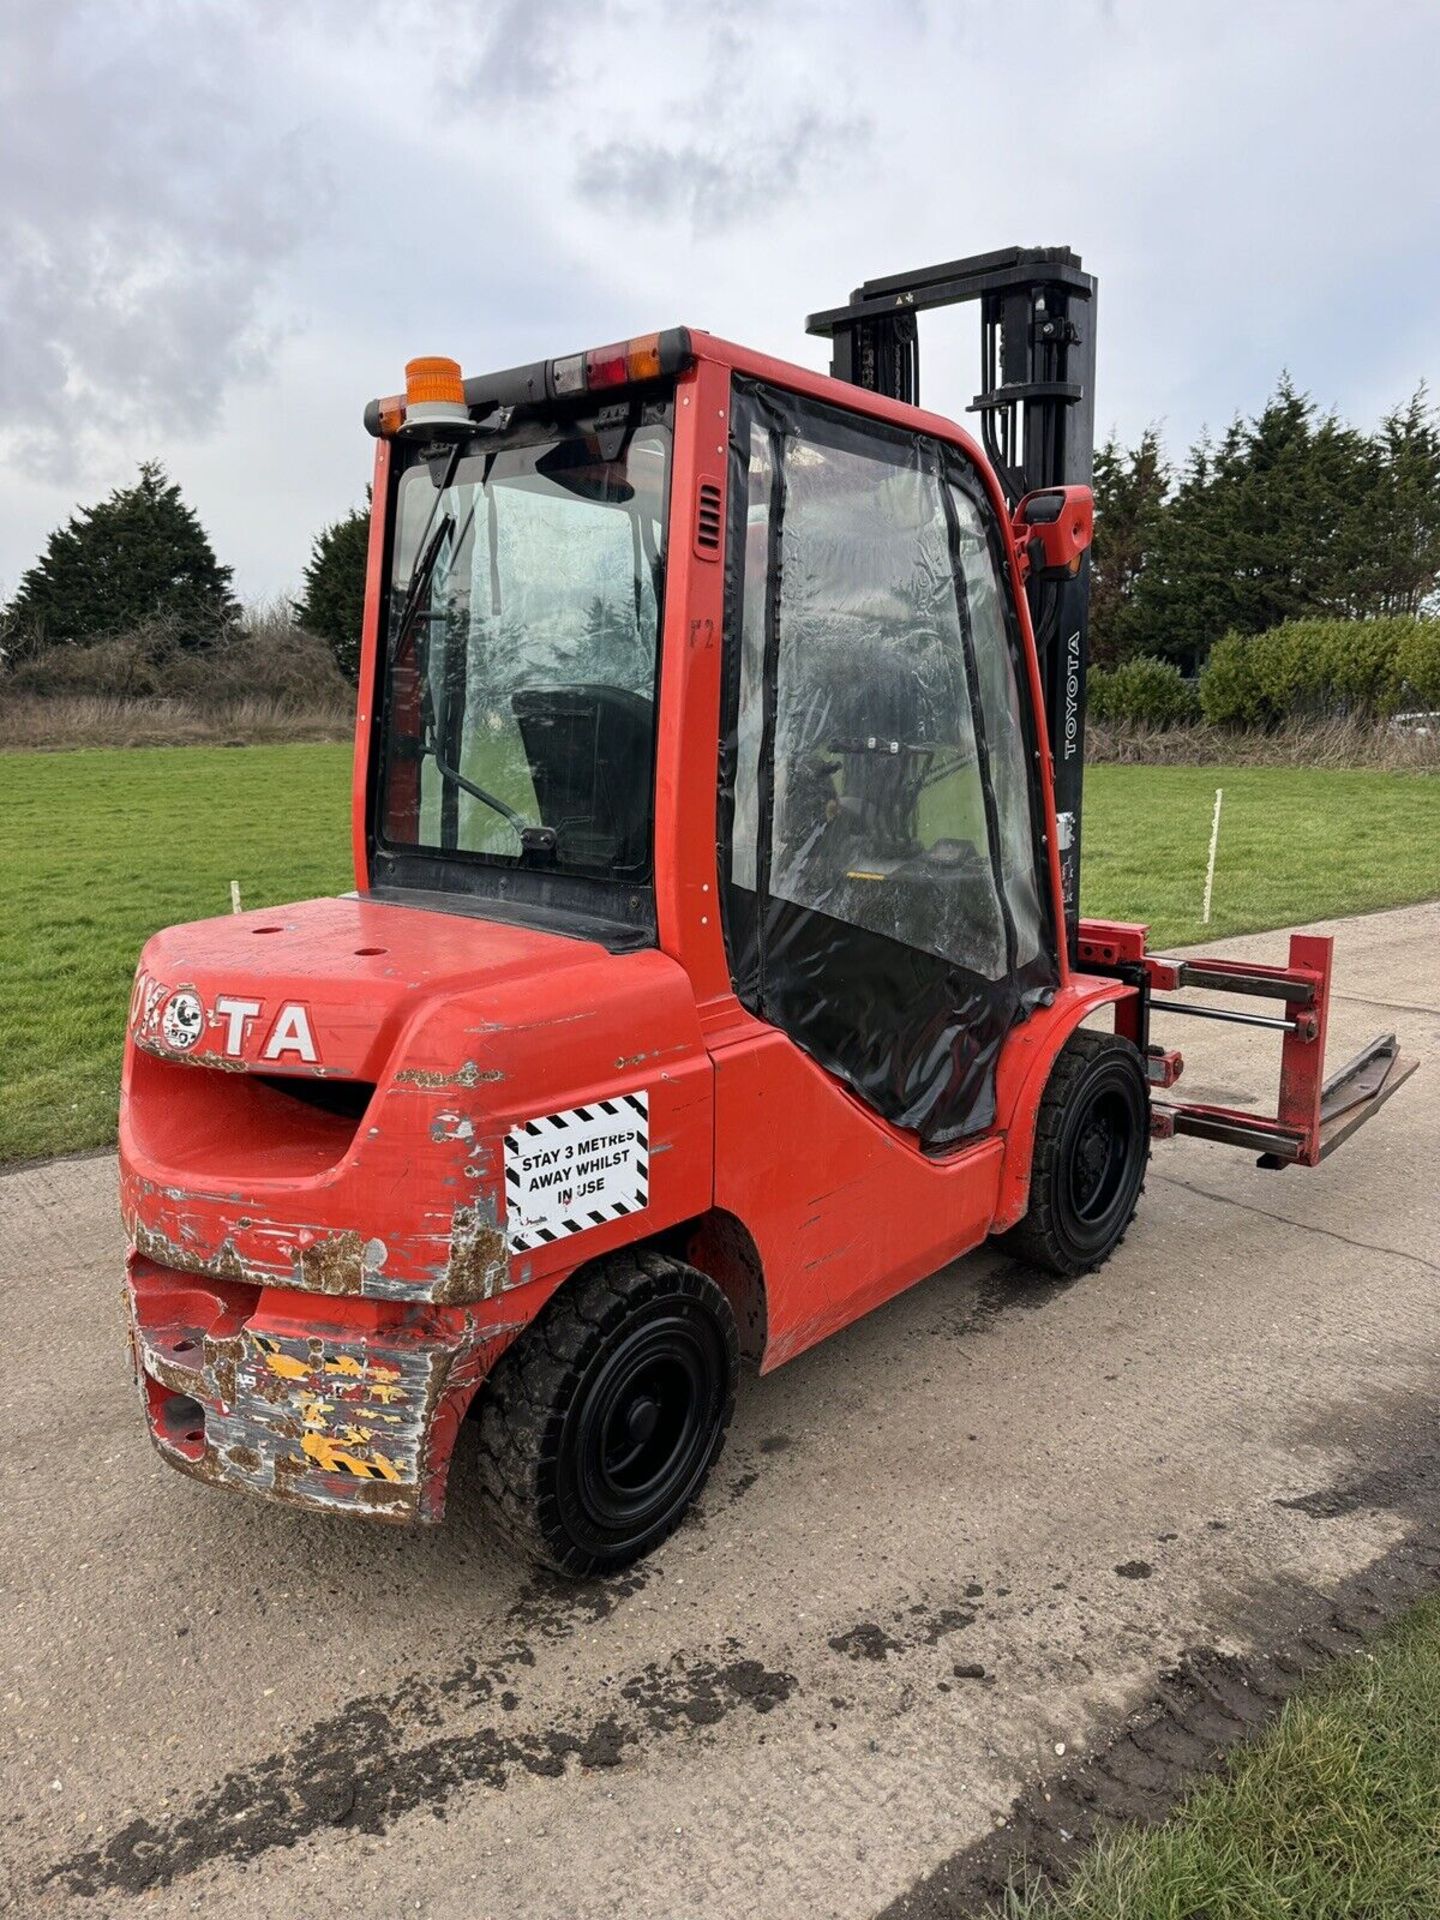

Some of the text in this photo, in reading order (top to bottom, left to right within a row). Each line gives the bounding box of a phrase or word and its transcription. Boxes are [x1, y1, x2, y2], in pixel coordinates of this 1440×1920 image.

[1064, 630, 1081, 760] TOYOTA
[522, 1131, 636, 1172] STAY 3 METRES
[528, 1149, 631, 1193] AWAY WHILST
[557, 1177, 606, 1205] IN USE
